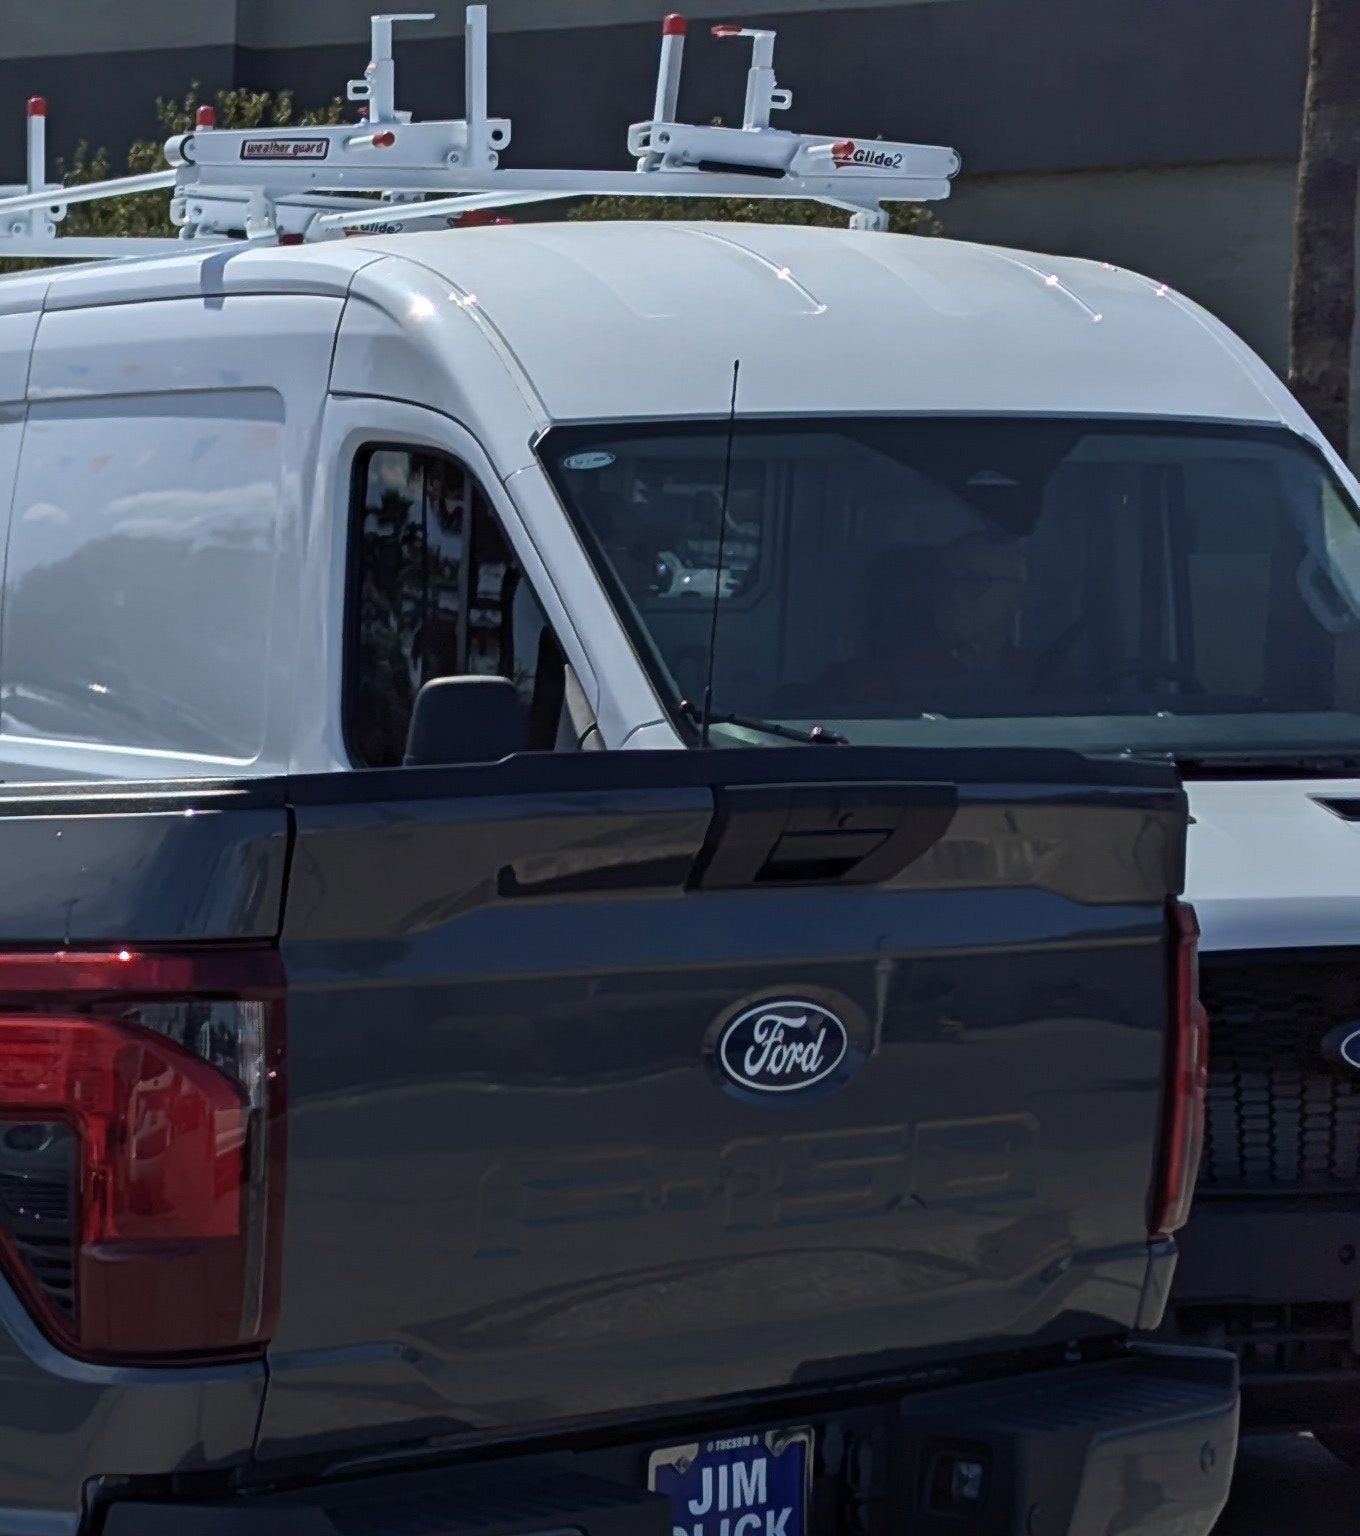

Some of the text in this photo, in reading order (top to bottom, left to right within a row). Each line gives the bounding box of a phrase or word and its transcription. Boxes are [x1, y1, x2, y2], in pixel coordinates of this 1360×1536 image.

[247, 141, 324, 153] weather guard
[744, 1014, 827, 1076] Ford
[471, 1110, 1042, 1259] F-150
[688, 1457, 768, 1516] JIM
